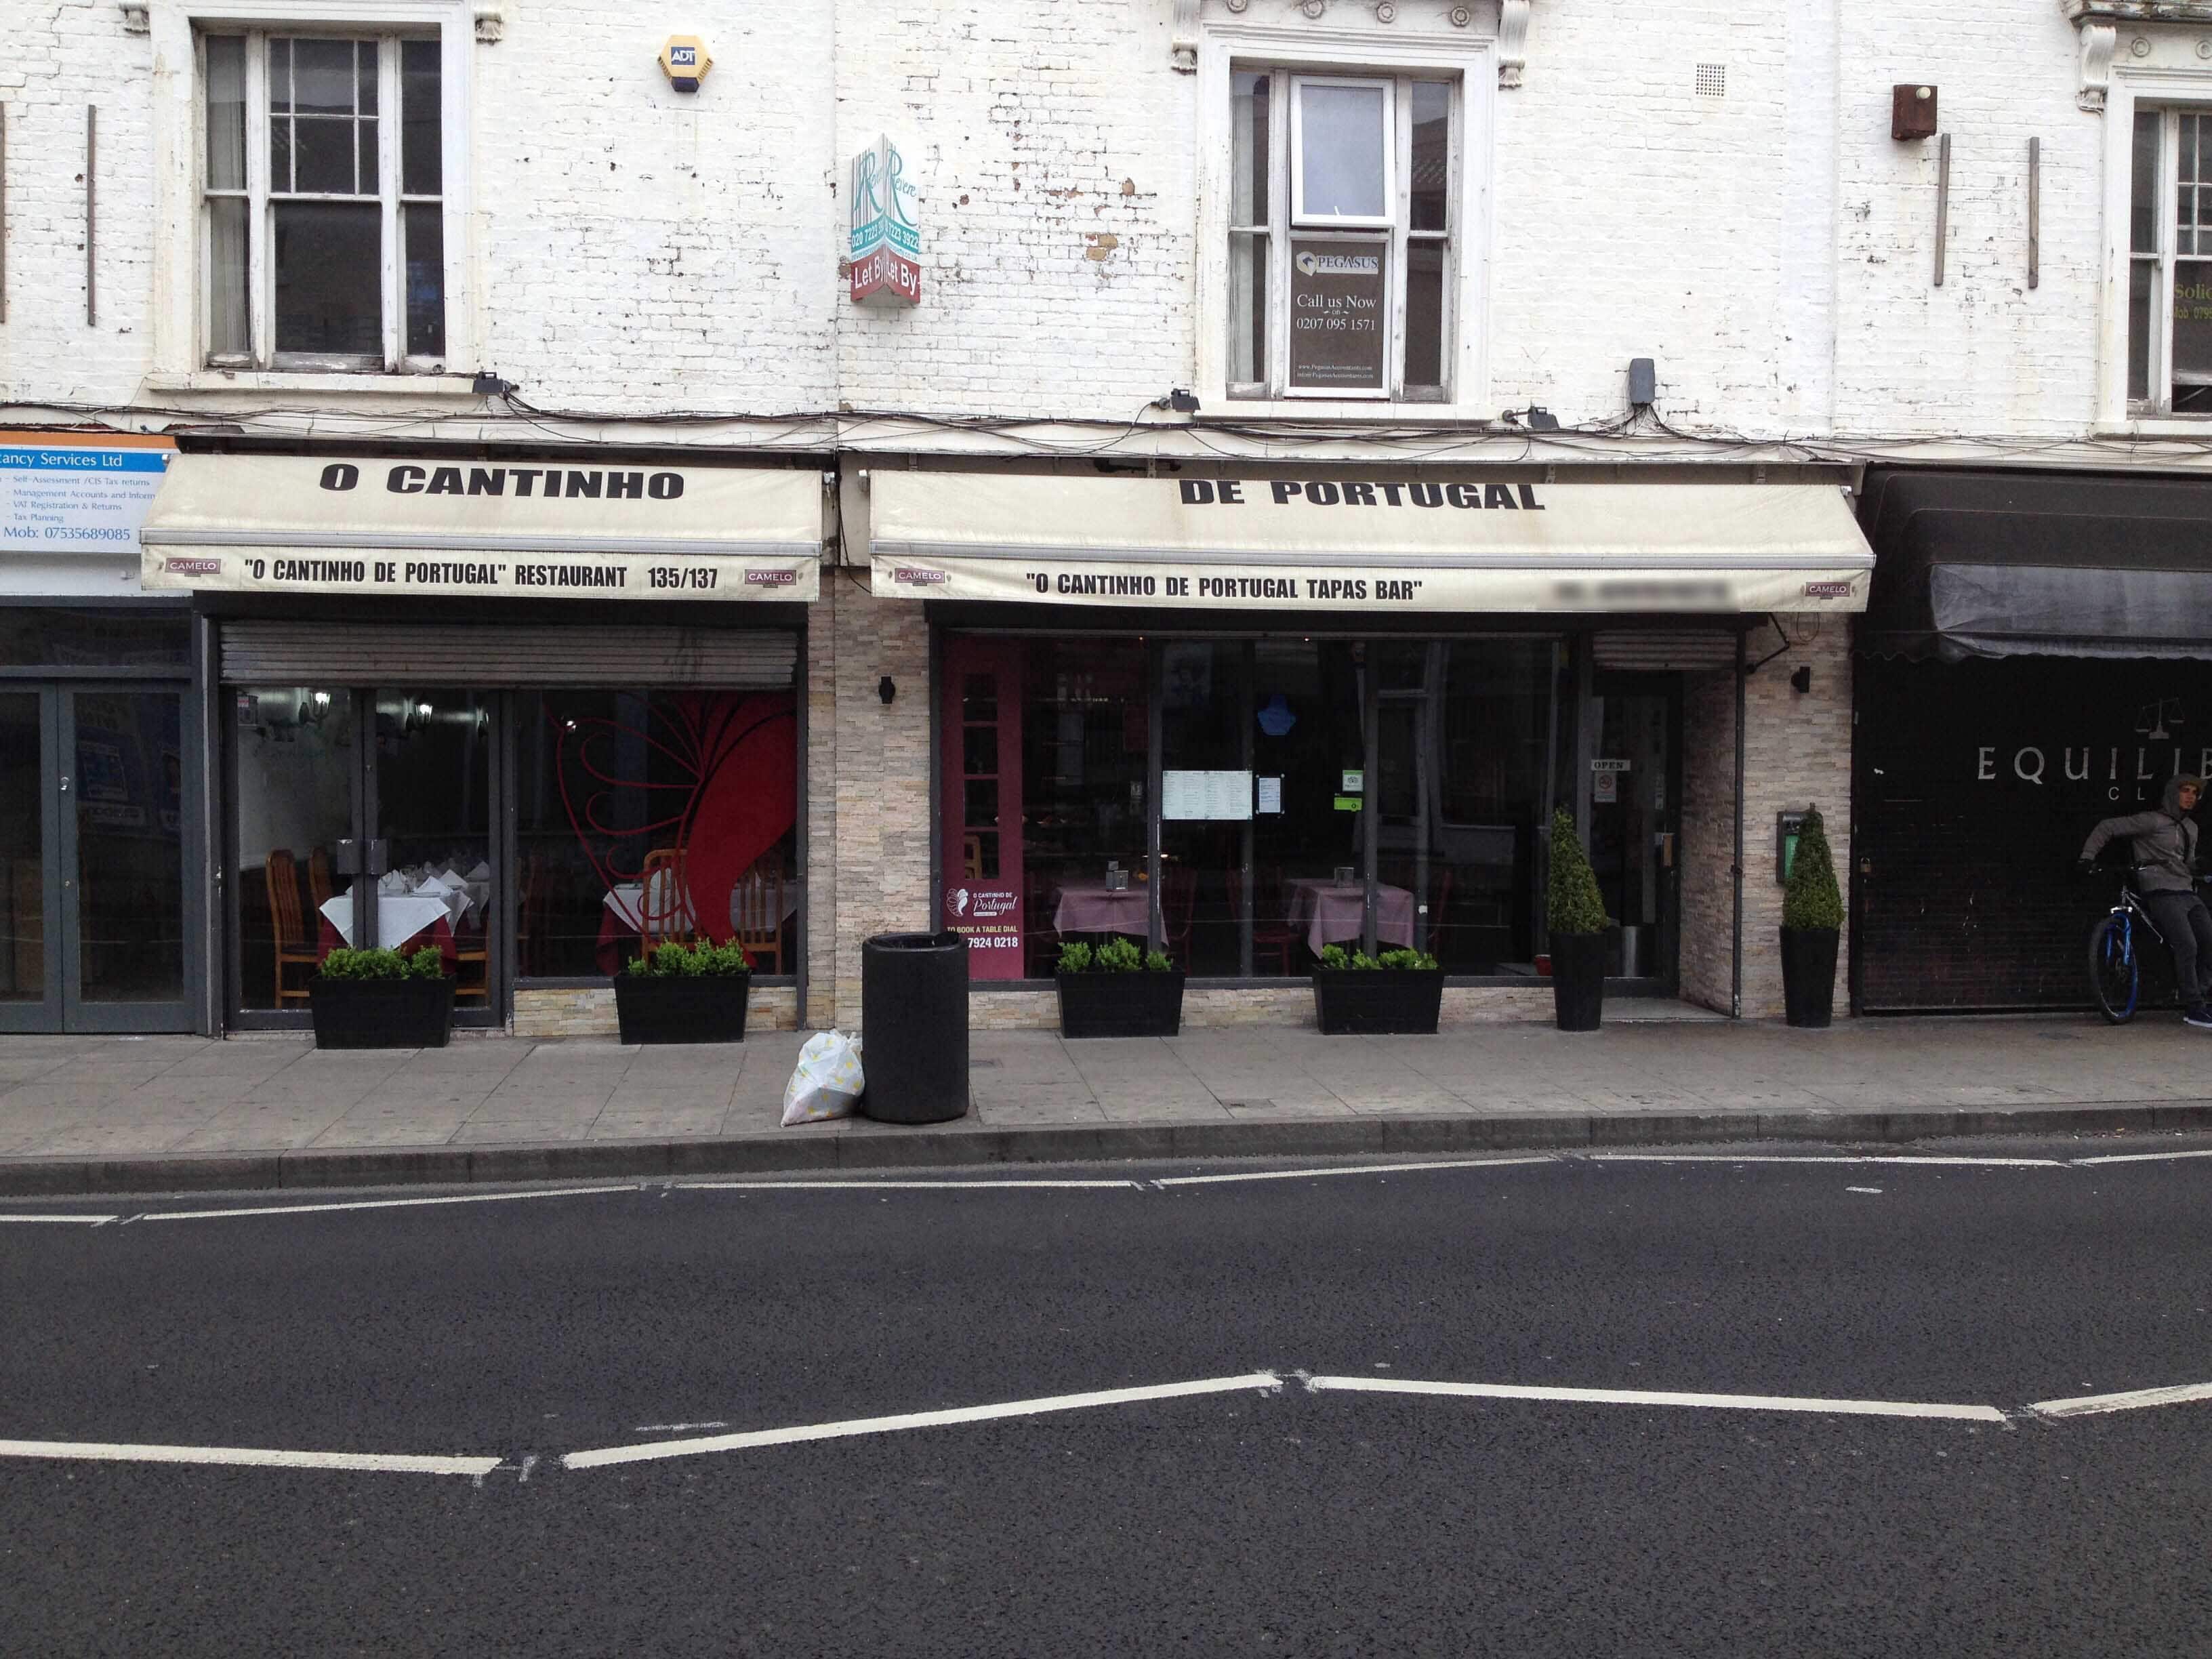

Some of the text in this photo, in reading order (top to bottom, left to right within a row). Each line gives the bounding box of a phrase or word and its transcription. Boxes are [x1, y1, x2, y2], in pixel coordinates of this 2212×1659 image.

[672, 49, 695, 62] ADT
[851, 232, 863, 247] 020
[865, 224, 878, 242] 7223
[902, 230, 918, 249] 3922
[1317, 255, 1378, 269] PEGASUS
[855, 255, 884, 289] Let By
[886, 252, 899, 283] Let
[901, 262, 917, 296] By
[1296, 293, 1377, 308] Call us Now
[1296, 318, 1375, 331] 0207 095 1571
[41, 453, 97, 466] Services
[102, 454, 123, 467] Ltd
[106, 477, 119, 485] Tax
[320, 464, 684, 499] O CANTINHO
[14, 489, 66, 498] Management
[70, 490, 108, 499] Accounts
[1179, 478, 1546, 511] DE PORTUGAL
[31, 501, 79, 510] Registration
[30, 513, 64, 523] Planning
[3, 526, 131, 540] Mob: 07535689085
[169, 562, 217, 570] CAMELO
[245, 558, 718, 589] "O CANTINHO DE PORTUGAL" RESTAURANT 135/137
[748, 573, 793, 581] CAMELO
[899, 571, 942, 580] CAMELO
[1026, 572, 1422, 600] "O CANTINHO DE PORTUGAL TAPAS BAR"
[1594, 761, 1624, 769] OPEN
[973, 896, 1018, 916] Portugal
[968, 937, 1018, 948] 7924 0218
